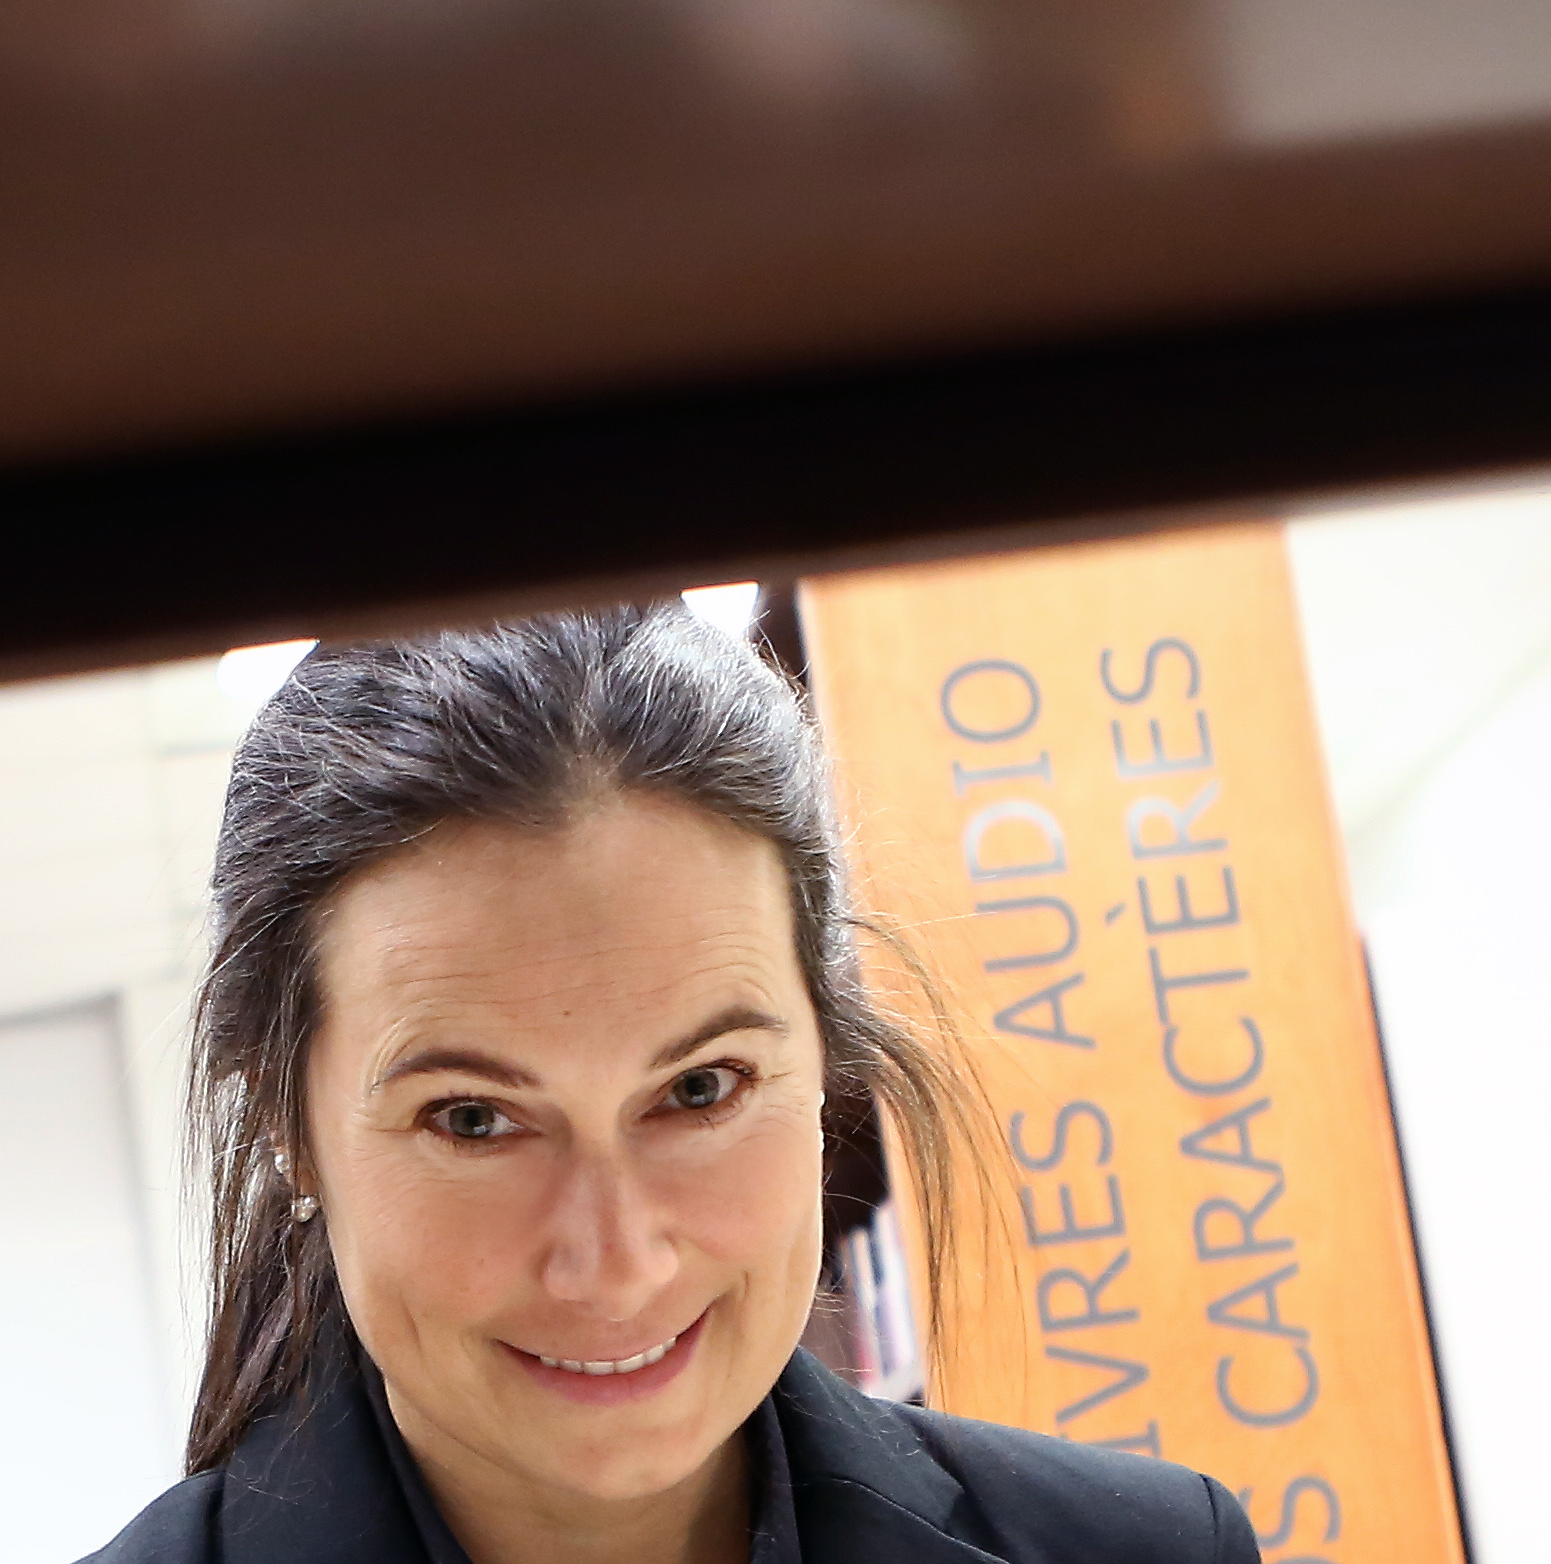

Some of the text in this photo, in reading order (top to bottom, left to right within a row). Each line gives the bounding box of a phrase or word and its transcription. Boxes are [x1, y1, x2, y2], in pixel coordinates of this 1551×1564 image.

[939, 657, 1163, 1459] IVRES AUDIO
[1099, 635, 1320, 1428] CARACTÈRES
